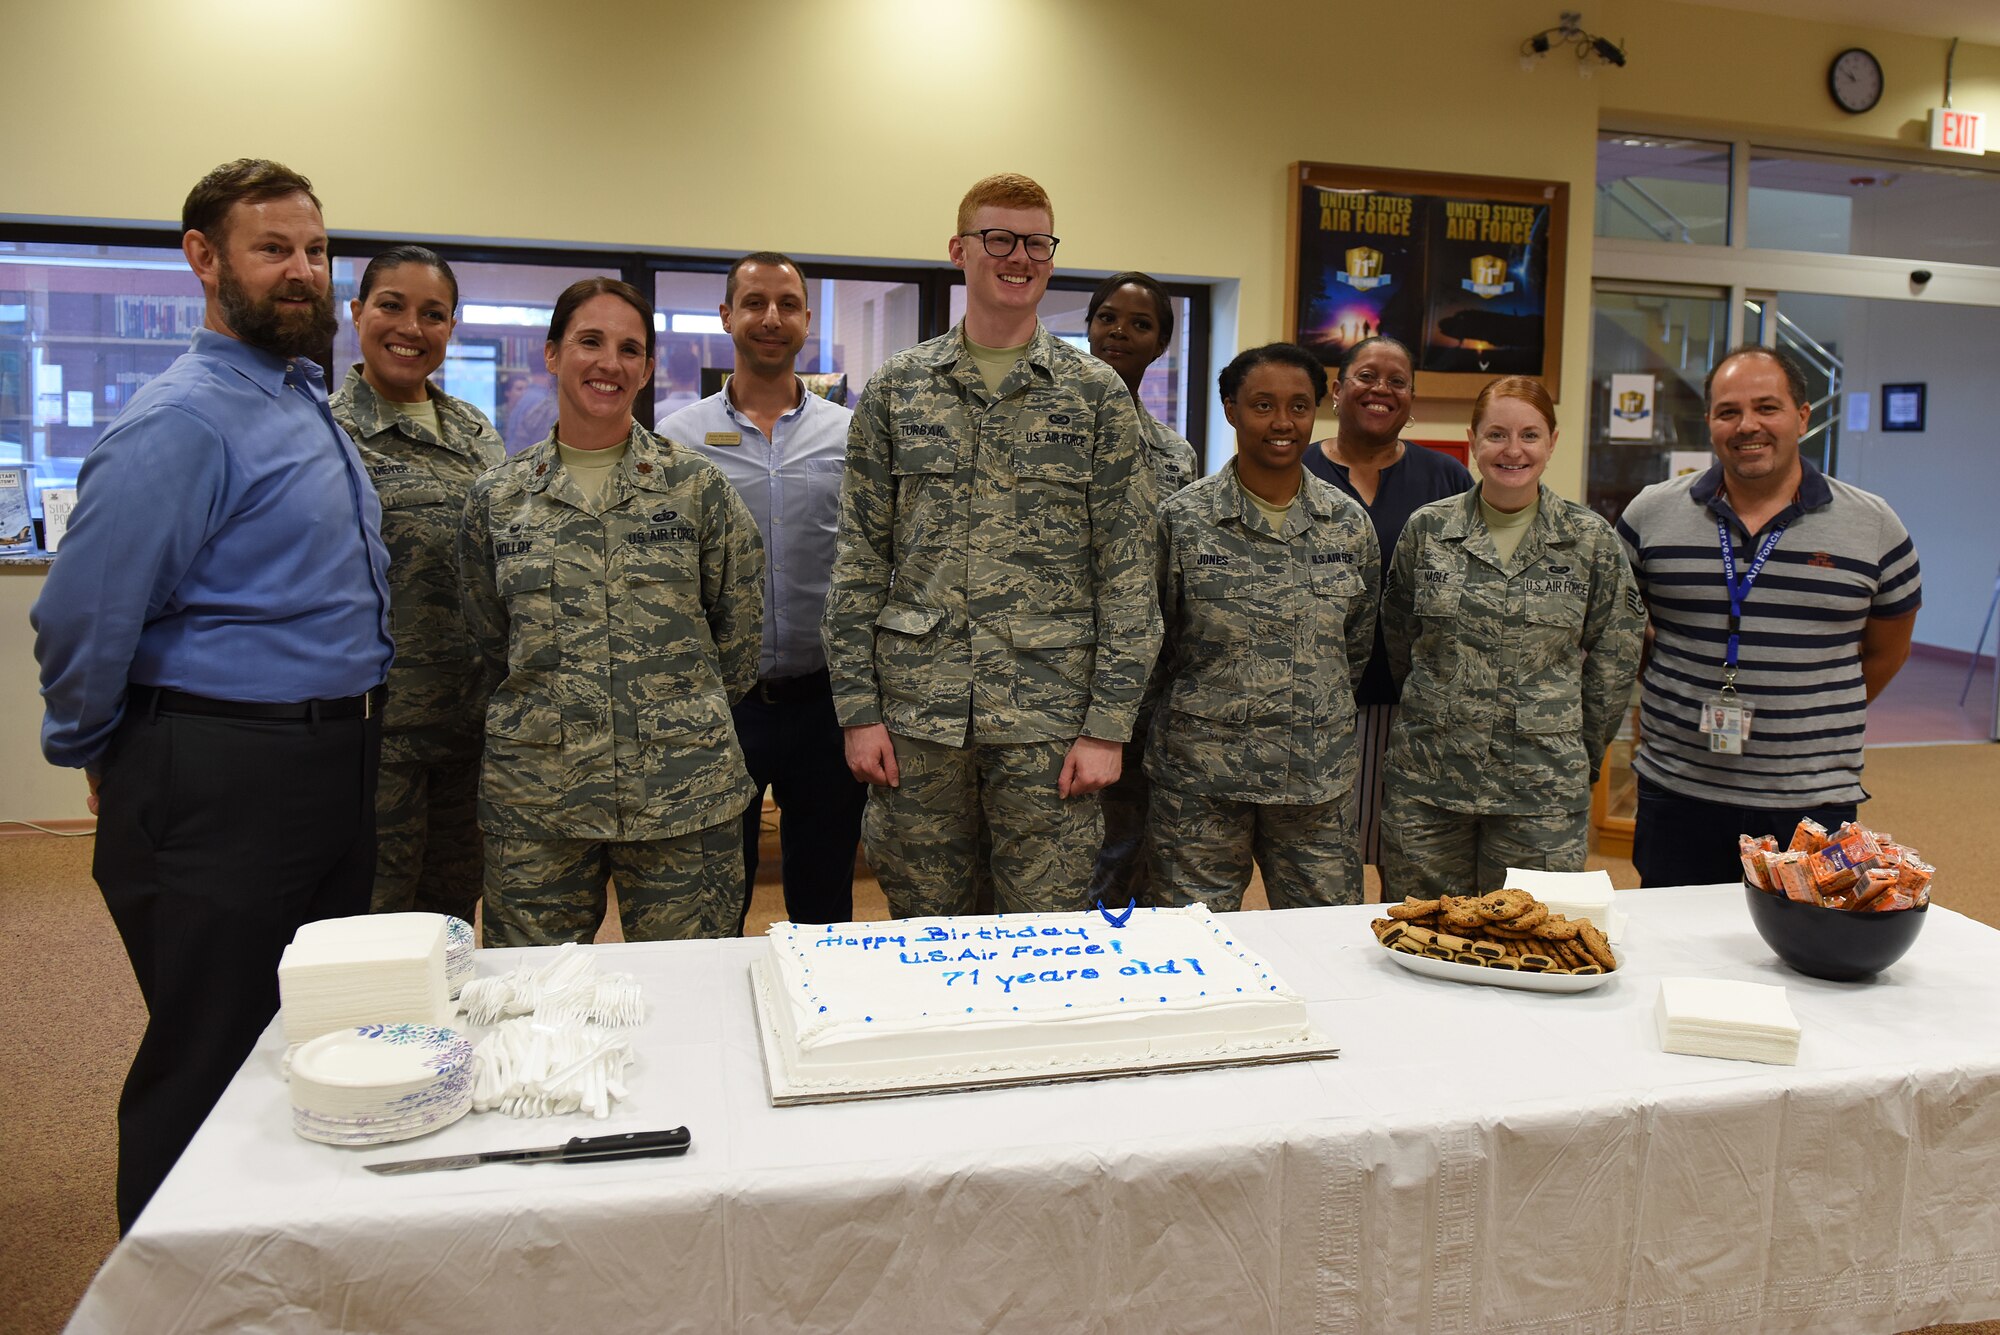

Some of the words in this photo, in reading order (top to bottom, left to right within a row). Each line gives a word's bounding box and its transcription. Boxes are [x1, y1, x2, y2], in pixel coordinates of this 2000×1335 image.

[1943, 112, 1979, 149] EXIT
[1320, 191, 1365, 210] UNITED
[1368, 195, 1413, 214] STATES
[1446, 201, 1491, 220] UNITED
[1492, 205, 1534, 223] STATES
[1320, 207, 1351, 232] AIR
[1356, 210, 1411, 236] FORCE
[1446, 217, 1476, 241] AIR
[1481, 219, 1533, 244] FORCE
[900, 425, 946, 437] TURBAK
[1026, 432, 1040, 443] U.S.
[1044, 432, 1061, 444] AIR
[1061, 433, 1087, 448] FORCE
[650, 528, 669, 541] AIR
[671, 527, 697, 541] FORCE
[1197, 554, 1229, 566] JONES
[1746, 561, 1763, 584] AIR
[1757, 530, 1782, 565] FORCE
[1425, 570, 1449, 583] NAGLE
[1526, 580, 1543, 591] U.S.
[1546, 580, 1562, 593] AIR
[1563, 581, 1589, 596] FORCE
[816, 925, 906, 950] Happy
[915, 926, 1089, 942] Birthday
[1012, 940, 1123, 958] Force!
[942, 969, 979, 986] 71
[995, 967, 1100, 993] years
[1119, 958, 1206, 976] old!
